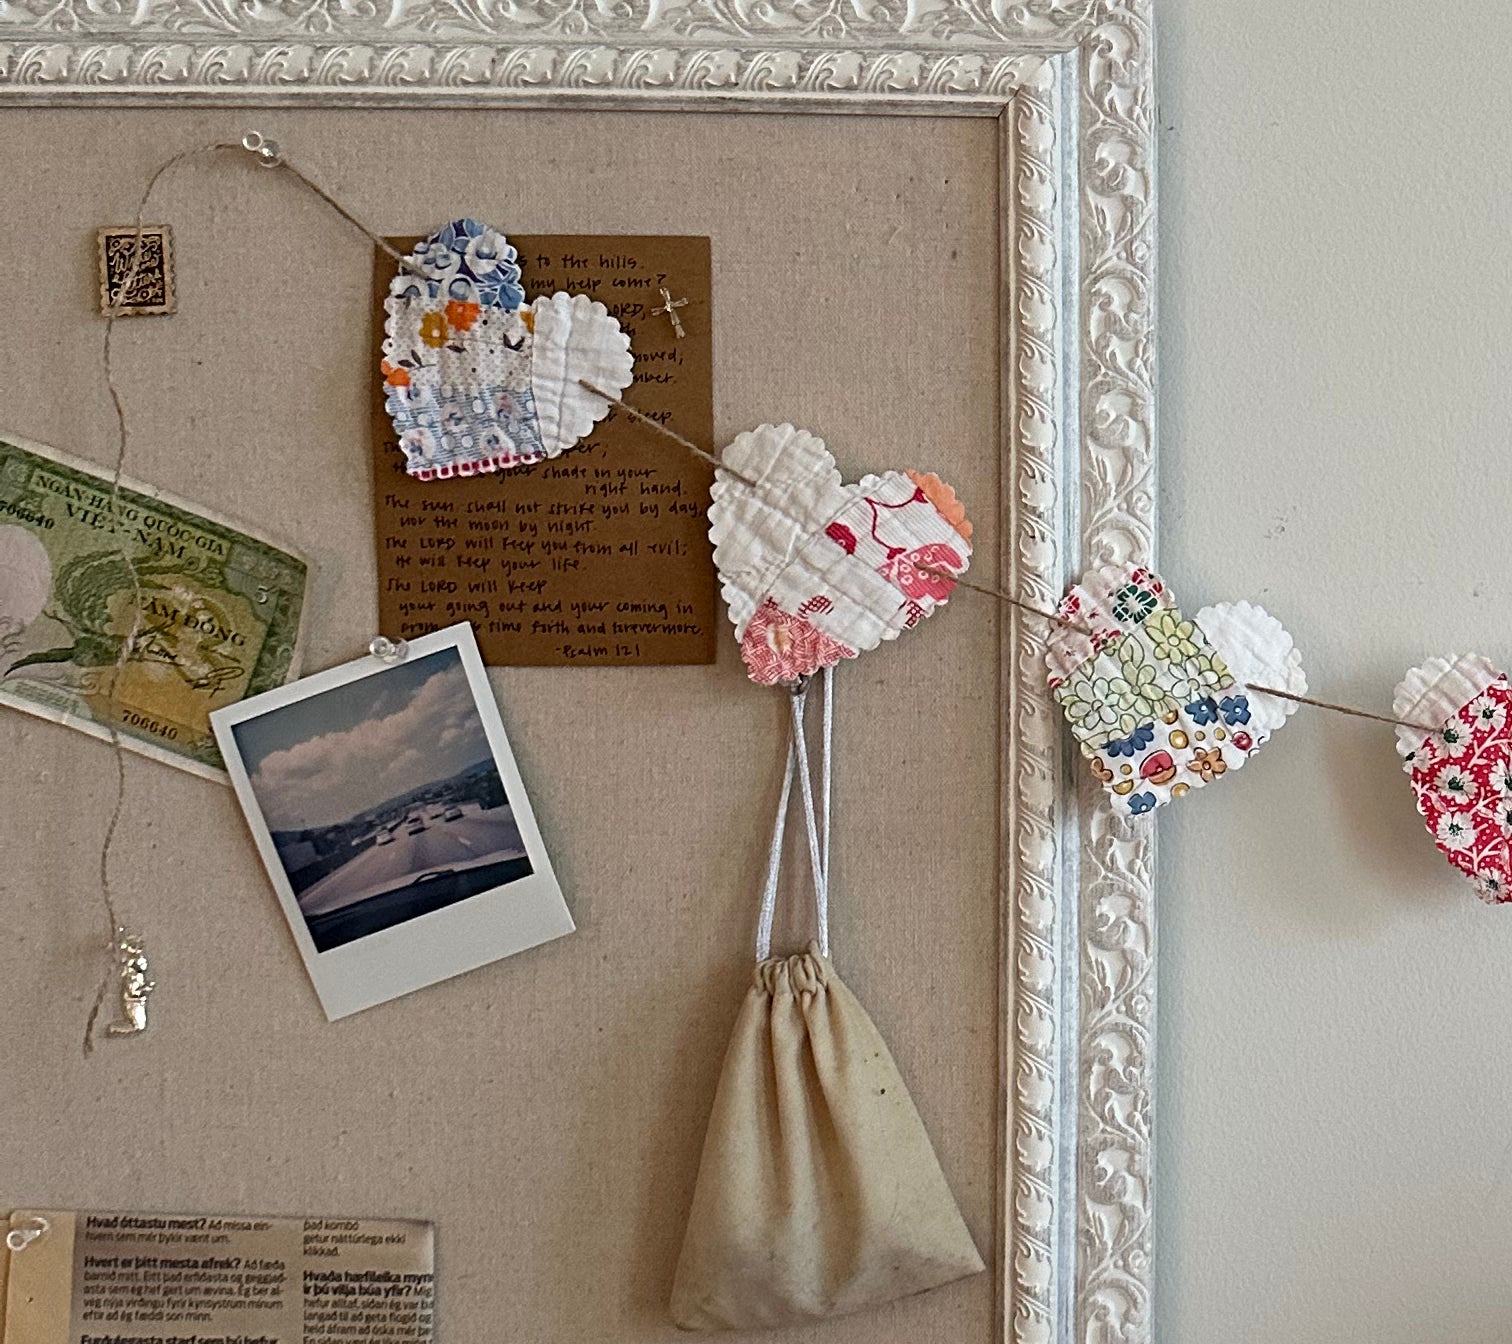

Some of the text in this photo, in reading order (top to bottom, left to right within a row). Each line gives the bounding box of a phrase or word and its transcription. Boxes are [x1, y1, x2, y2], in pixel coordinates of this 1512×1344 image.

[536, 254, 551, 268] to
[561, 254, 589, 269] the
[599, 253, 645, 269] hills.
[530, 273, 666, 293] my help come?
[612, 302, 646, 320] ORD,
[543, 466, 587, 478] shade
[595, 468, 611, 478] on
[617, 468, 657, 484] your
[585, 480, 688, 497] right hand.
[385, 494, 704, 520] The sun shall not strike you by day,
[400, 517, 427, 528] nor
[433, 516, 458, 529] the
[469, 520, 509, 532] moon
[519, 520, 538, 537] by
[385, 536, 408, 549] The
[420, 537, 456, 550] LORD
[465, 538, 494, 549] will
[502, 536, 535, 555] keep
[541, 540, 568, 555] you
[573, 540, 612, 556] from
[619, 539, 638, 556] all
[396, 554, 587, 577] He will keep your life.
[386, 577, 547, 594] The LORD will keep
[399, 600, 693, 620] your going out and your coming in
[489, 622, 522, 632] time
[532, 620, 570, 634] forth
[577, 622, 606, 634] and
[613, 622, 704, 635] forevermore.
[616, 644, 641, 656] 121
[123, 709, 177, 740] 706640
[87, 1216, 205, 1230] Hvað óttastu mest?
[84, 1256, 240, 1271] Hvert er þitt mesta afrek?
[304, 1271, 342, 1282] Hvaða
